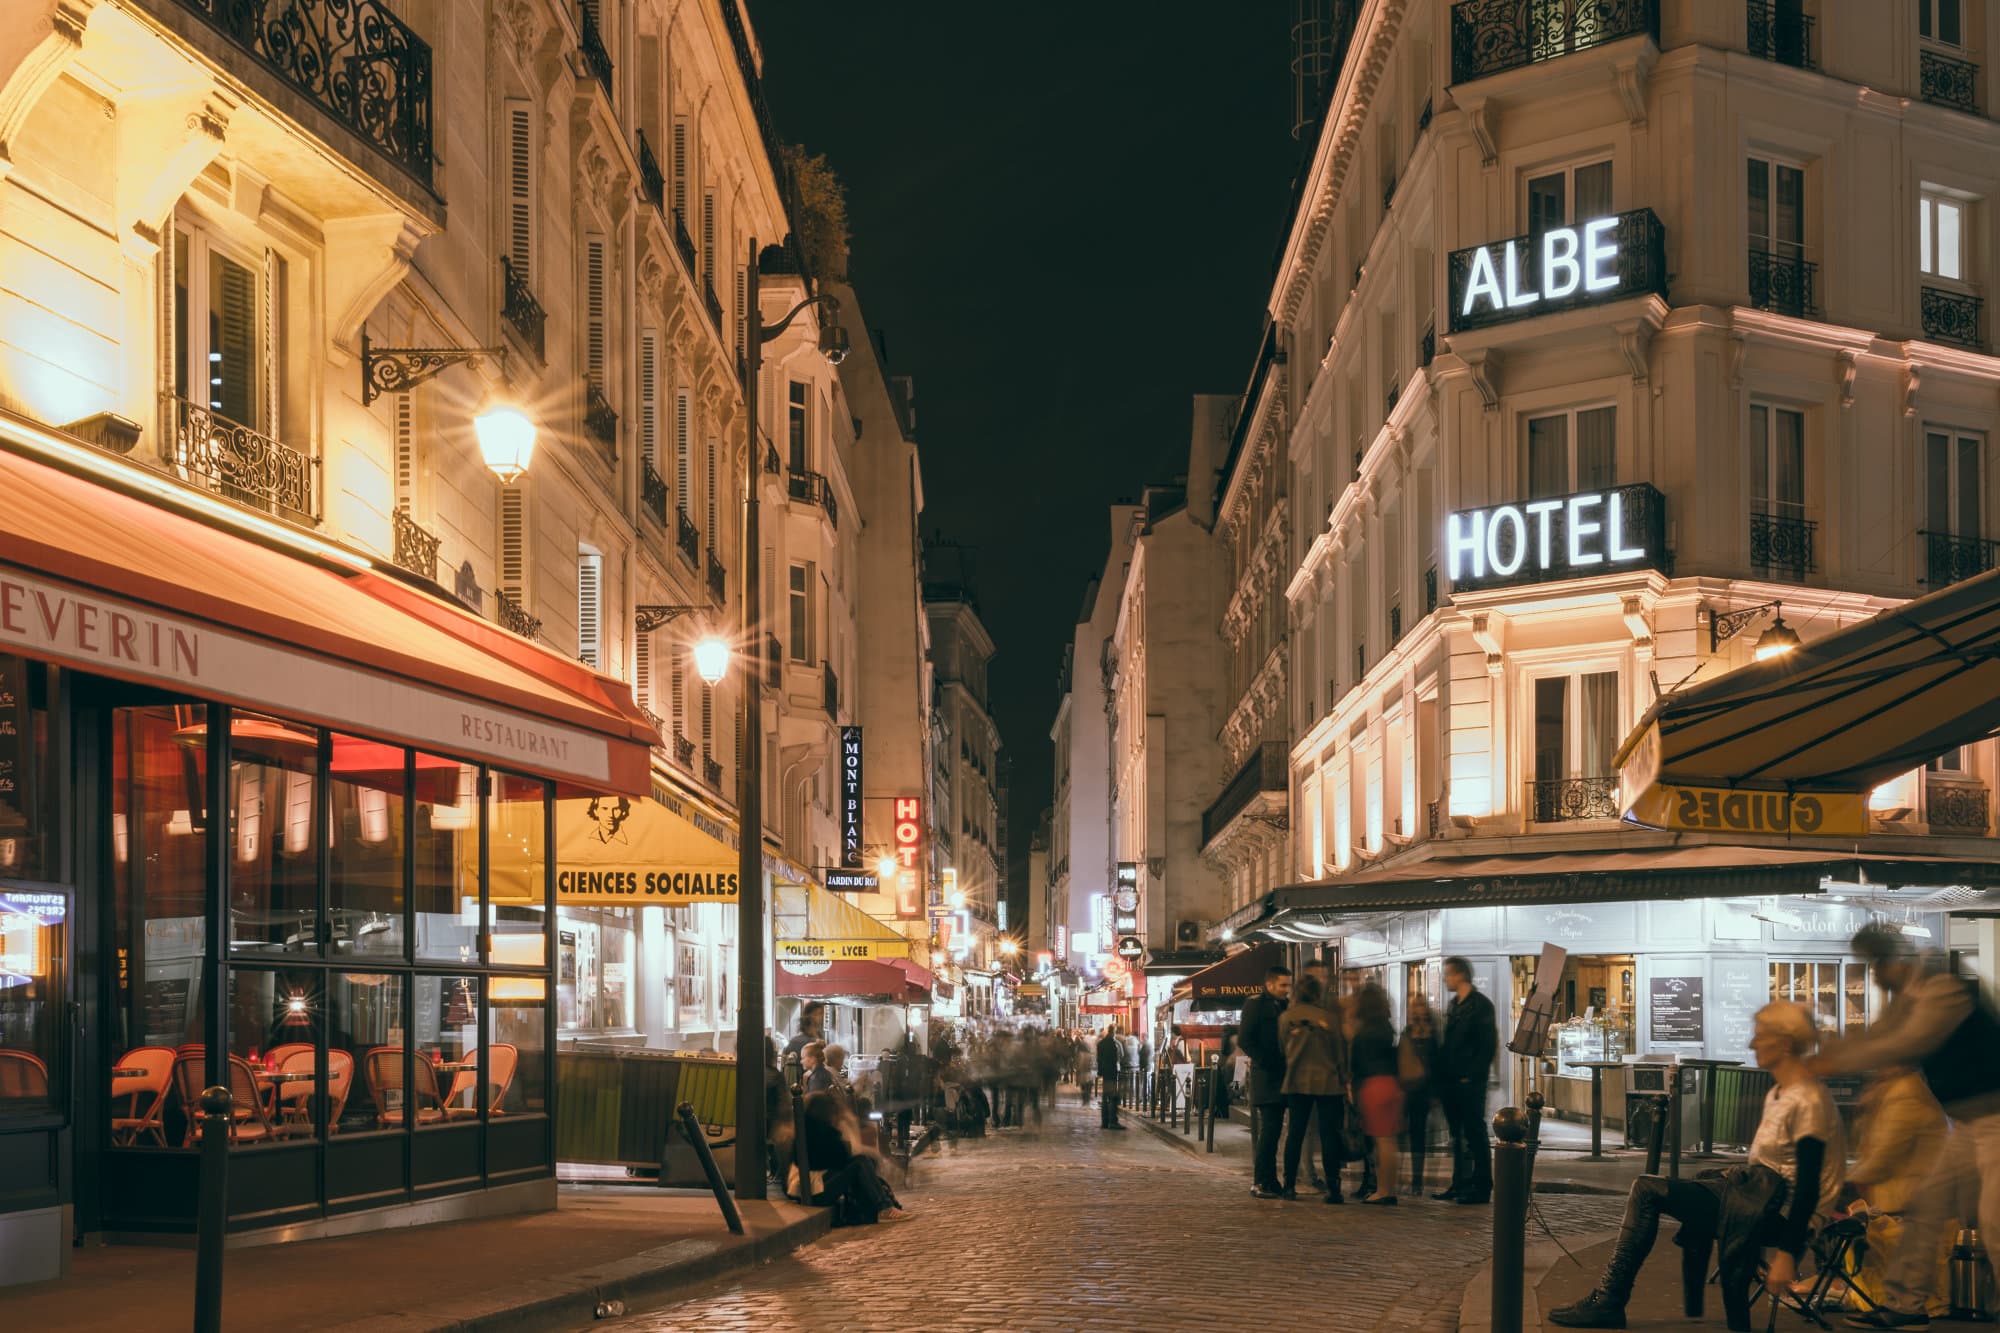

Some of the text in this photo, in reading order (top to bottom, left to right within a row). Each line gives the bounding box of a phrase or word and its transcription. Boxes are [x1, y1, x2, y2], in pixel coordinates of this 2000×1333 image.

[1463, 217, 1620, 315] ALBE
[1448, 493, 1646, 581] HOTEL
[1, 581, 199, 677] EVERIN
[461, 714, 569, 760] RESTAURANT
[845, 742, 860, 864] MONT BLANC
[896, 798, 920, 914] HOTEL
[558, 871, 739, 896] CIENCES SOCIALES
[827, 875, 878, 887] JARDIN DU ROI
[1788, 909, 1837, 933] Salon
[1845, 911, 1862, 933] de
[785, 945, 868, 956] COLLEGE LYCEE
[1220, 985, 1263, 996] FRANÇAIS
